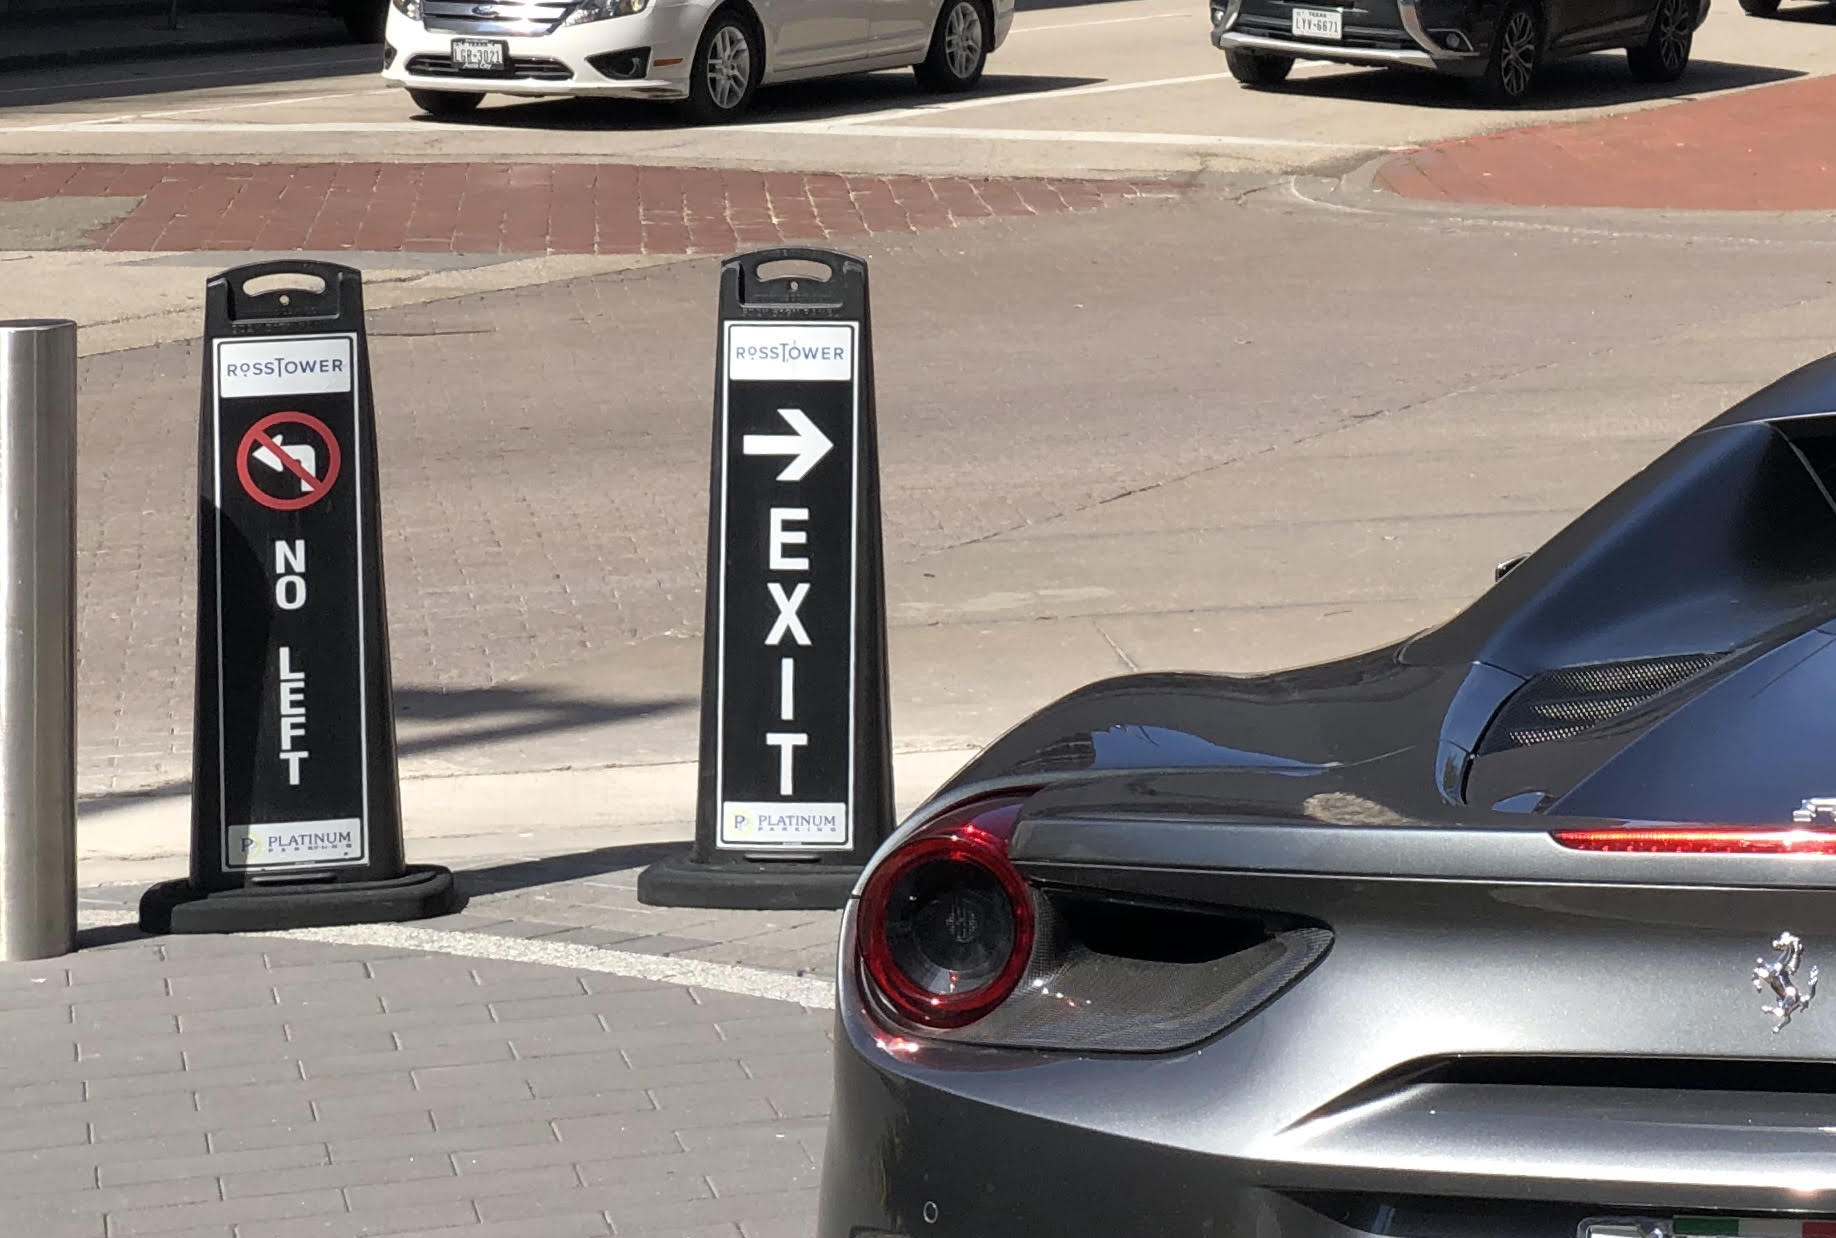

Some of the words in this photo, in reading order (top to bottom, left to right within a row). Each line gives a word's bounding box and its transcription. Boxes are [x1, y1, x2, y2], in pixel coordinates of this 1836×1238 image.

[274, 539, 307, 611] NO
[763, 507, 813, 796] EXIT
[278, 646, 310, 786] LEFT
[267, 831, 352, 848] PLATINUM
[757, 814, 837, 827] PLATINUM
